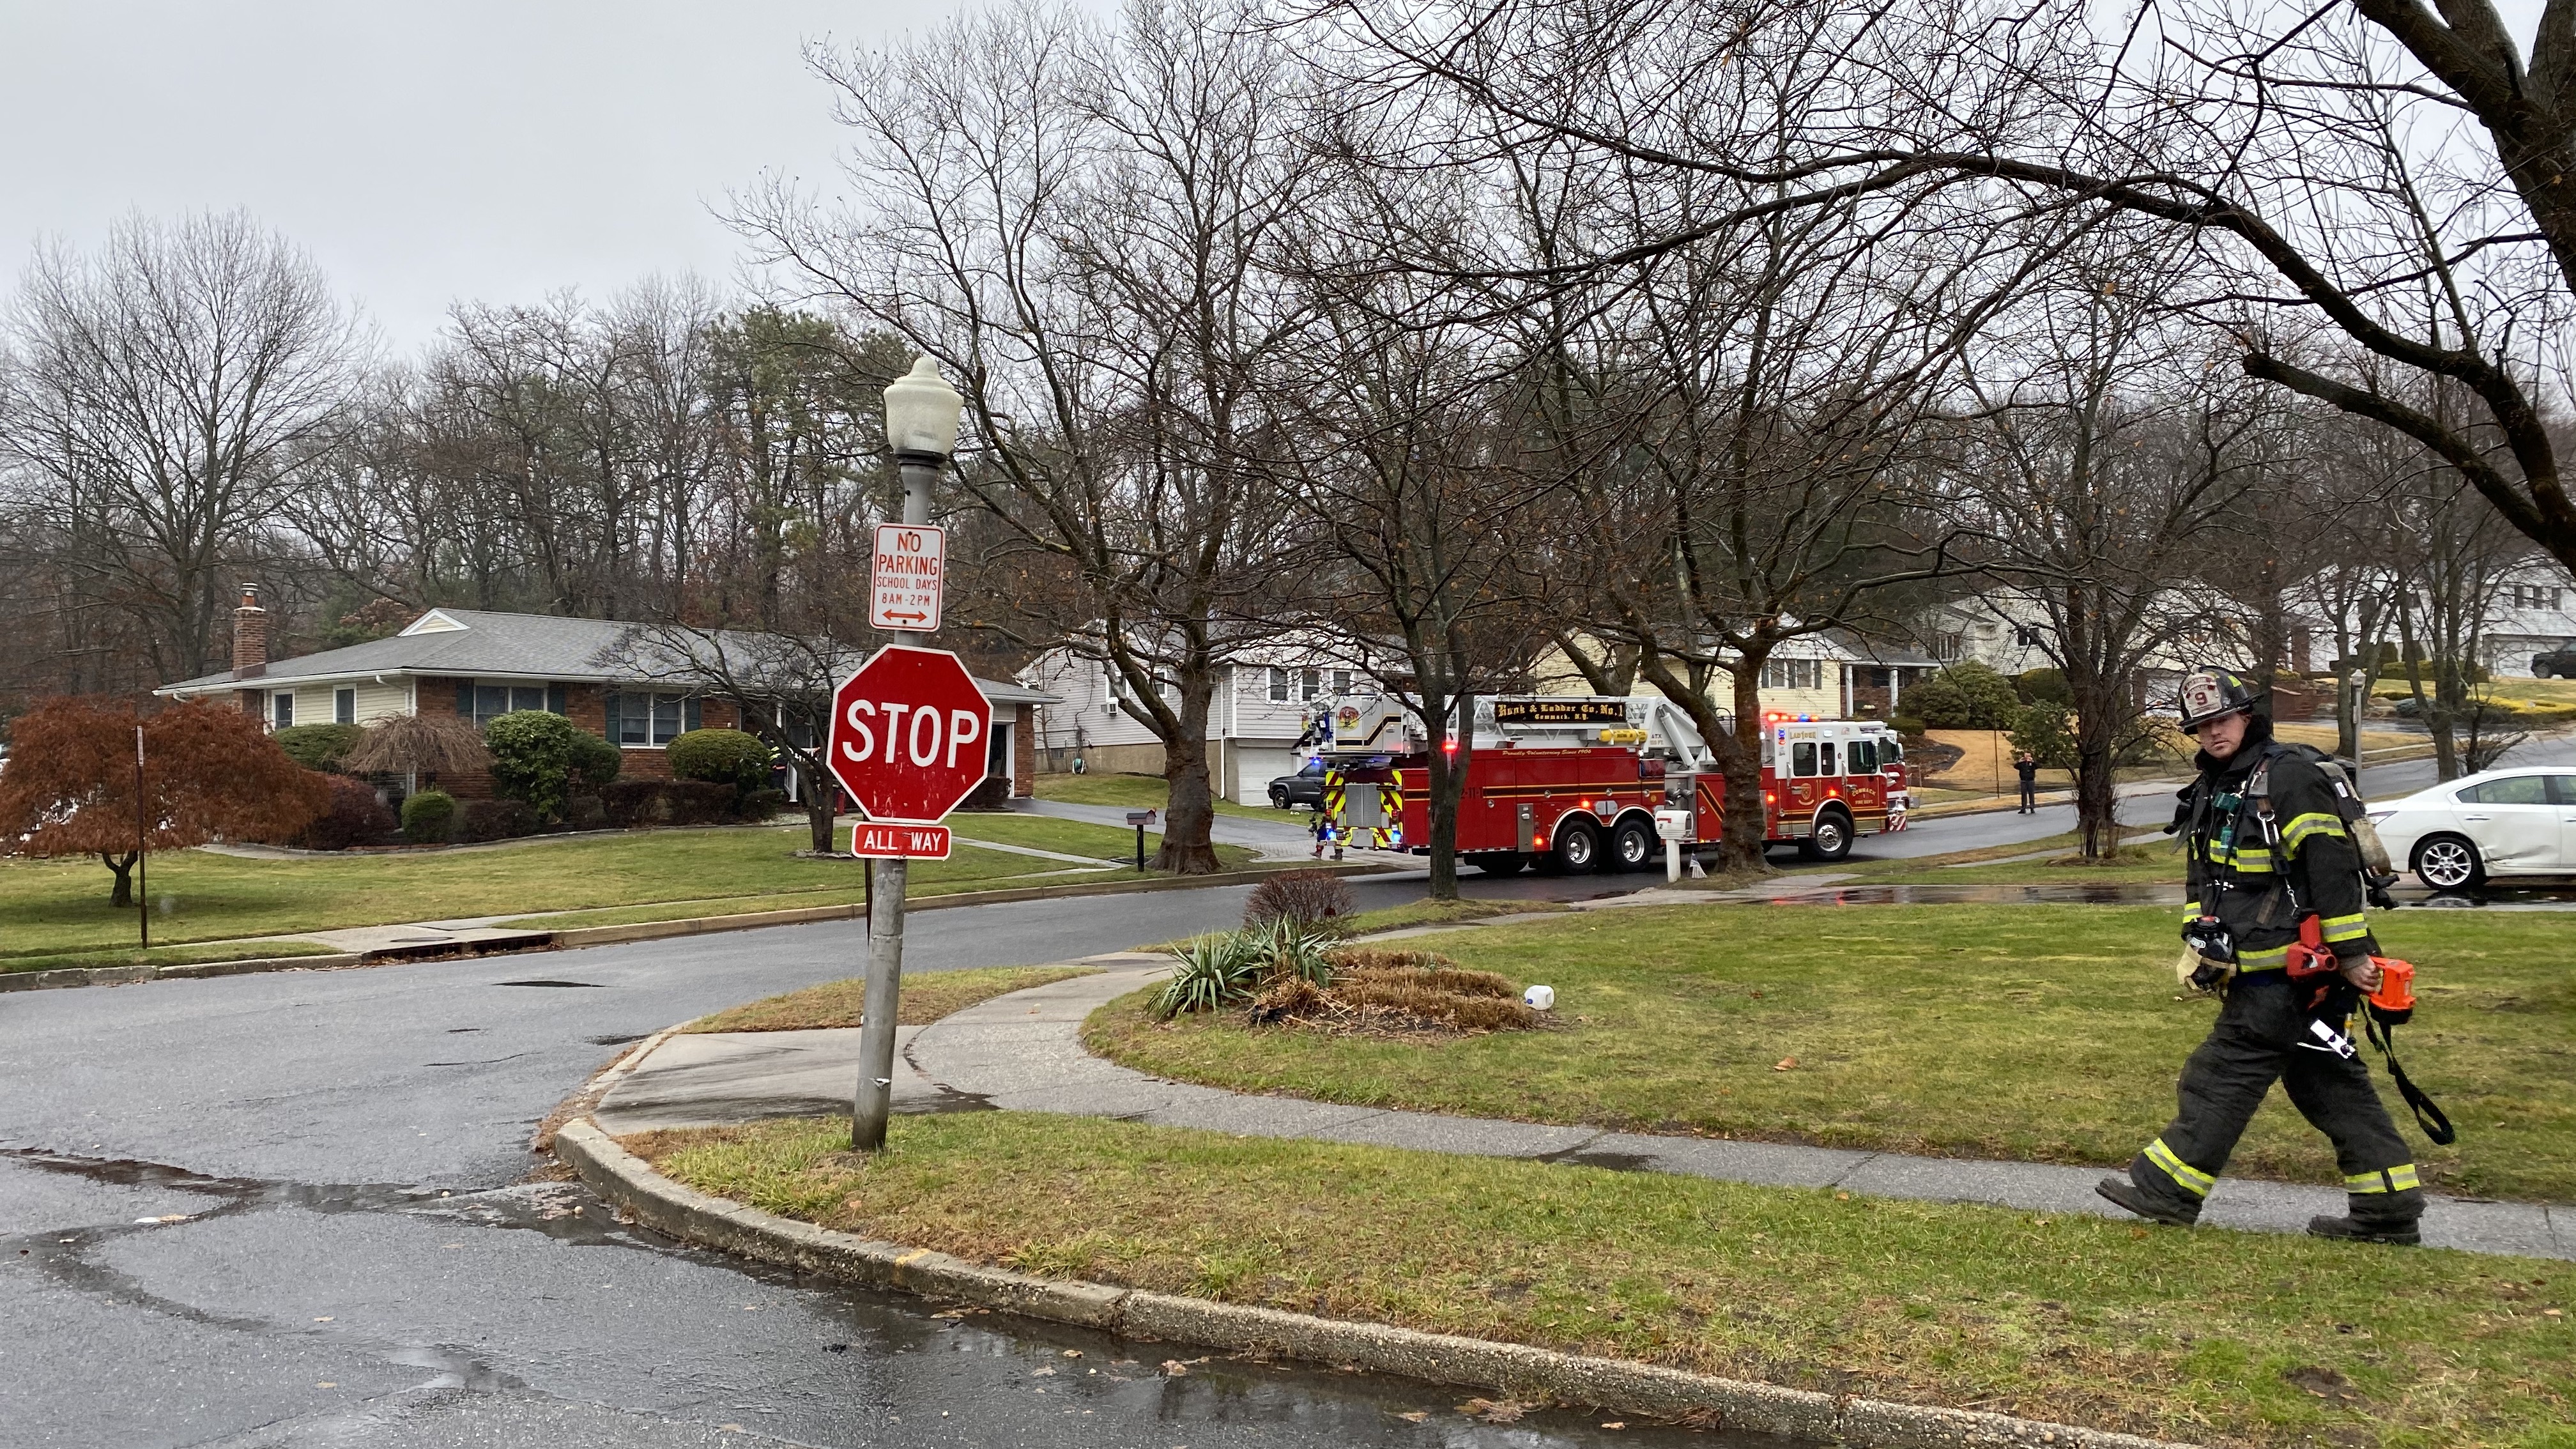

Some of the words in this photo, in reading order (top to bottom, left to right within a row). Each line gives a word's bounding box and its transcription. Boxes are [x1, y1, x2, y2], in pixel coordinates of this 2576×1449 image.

[897, 533, 921, 553] NO
[878, 554, 937, 576] PARKING
[877, 576, 910, 589] SCHOOL
[916, 578, 937, 590] DAYS
[2195, 692, 2208, 705] 9
[1529, 704, 1537, 712] &
[1540, 704, 1576, 712] Ladder
[1618, 705, 1623, 717] 1
[842, 699, 980, 769] STOP
[1851, 788, 1876, 797] COMMACK
[863, 829, 898, 851] ALL
[911, 831, 943, 853] WAY
